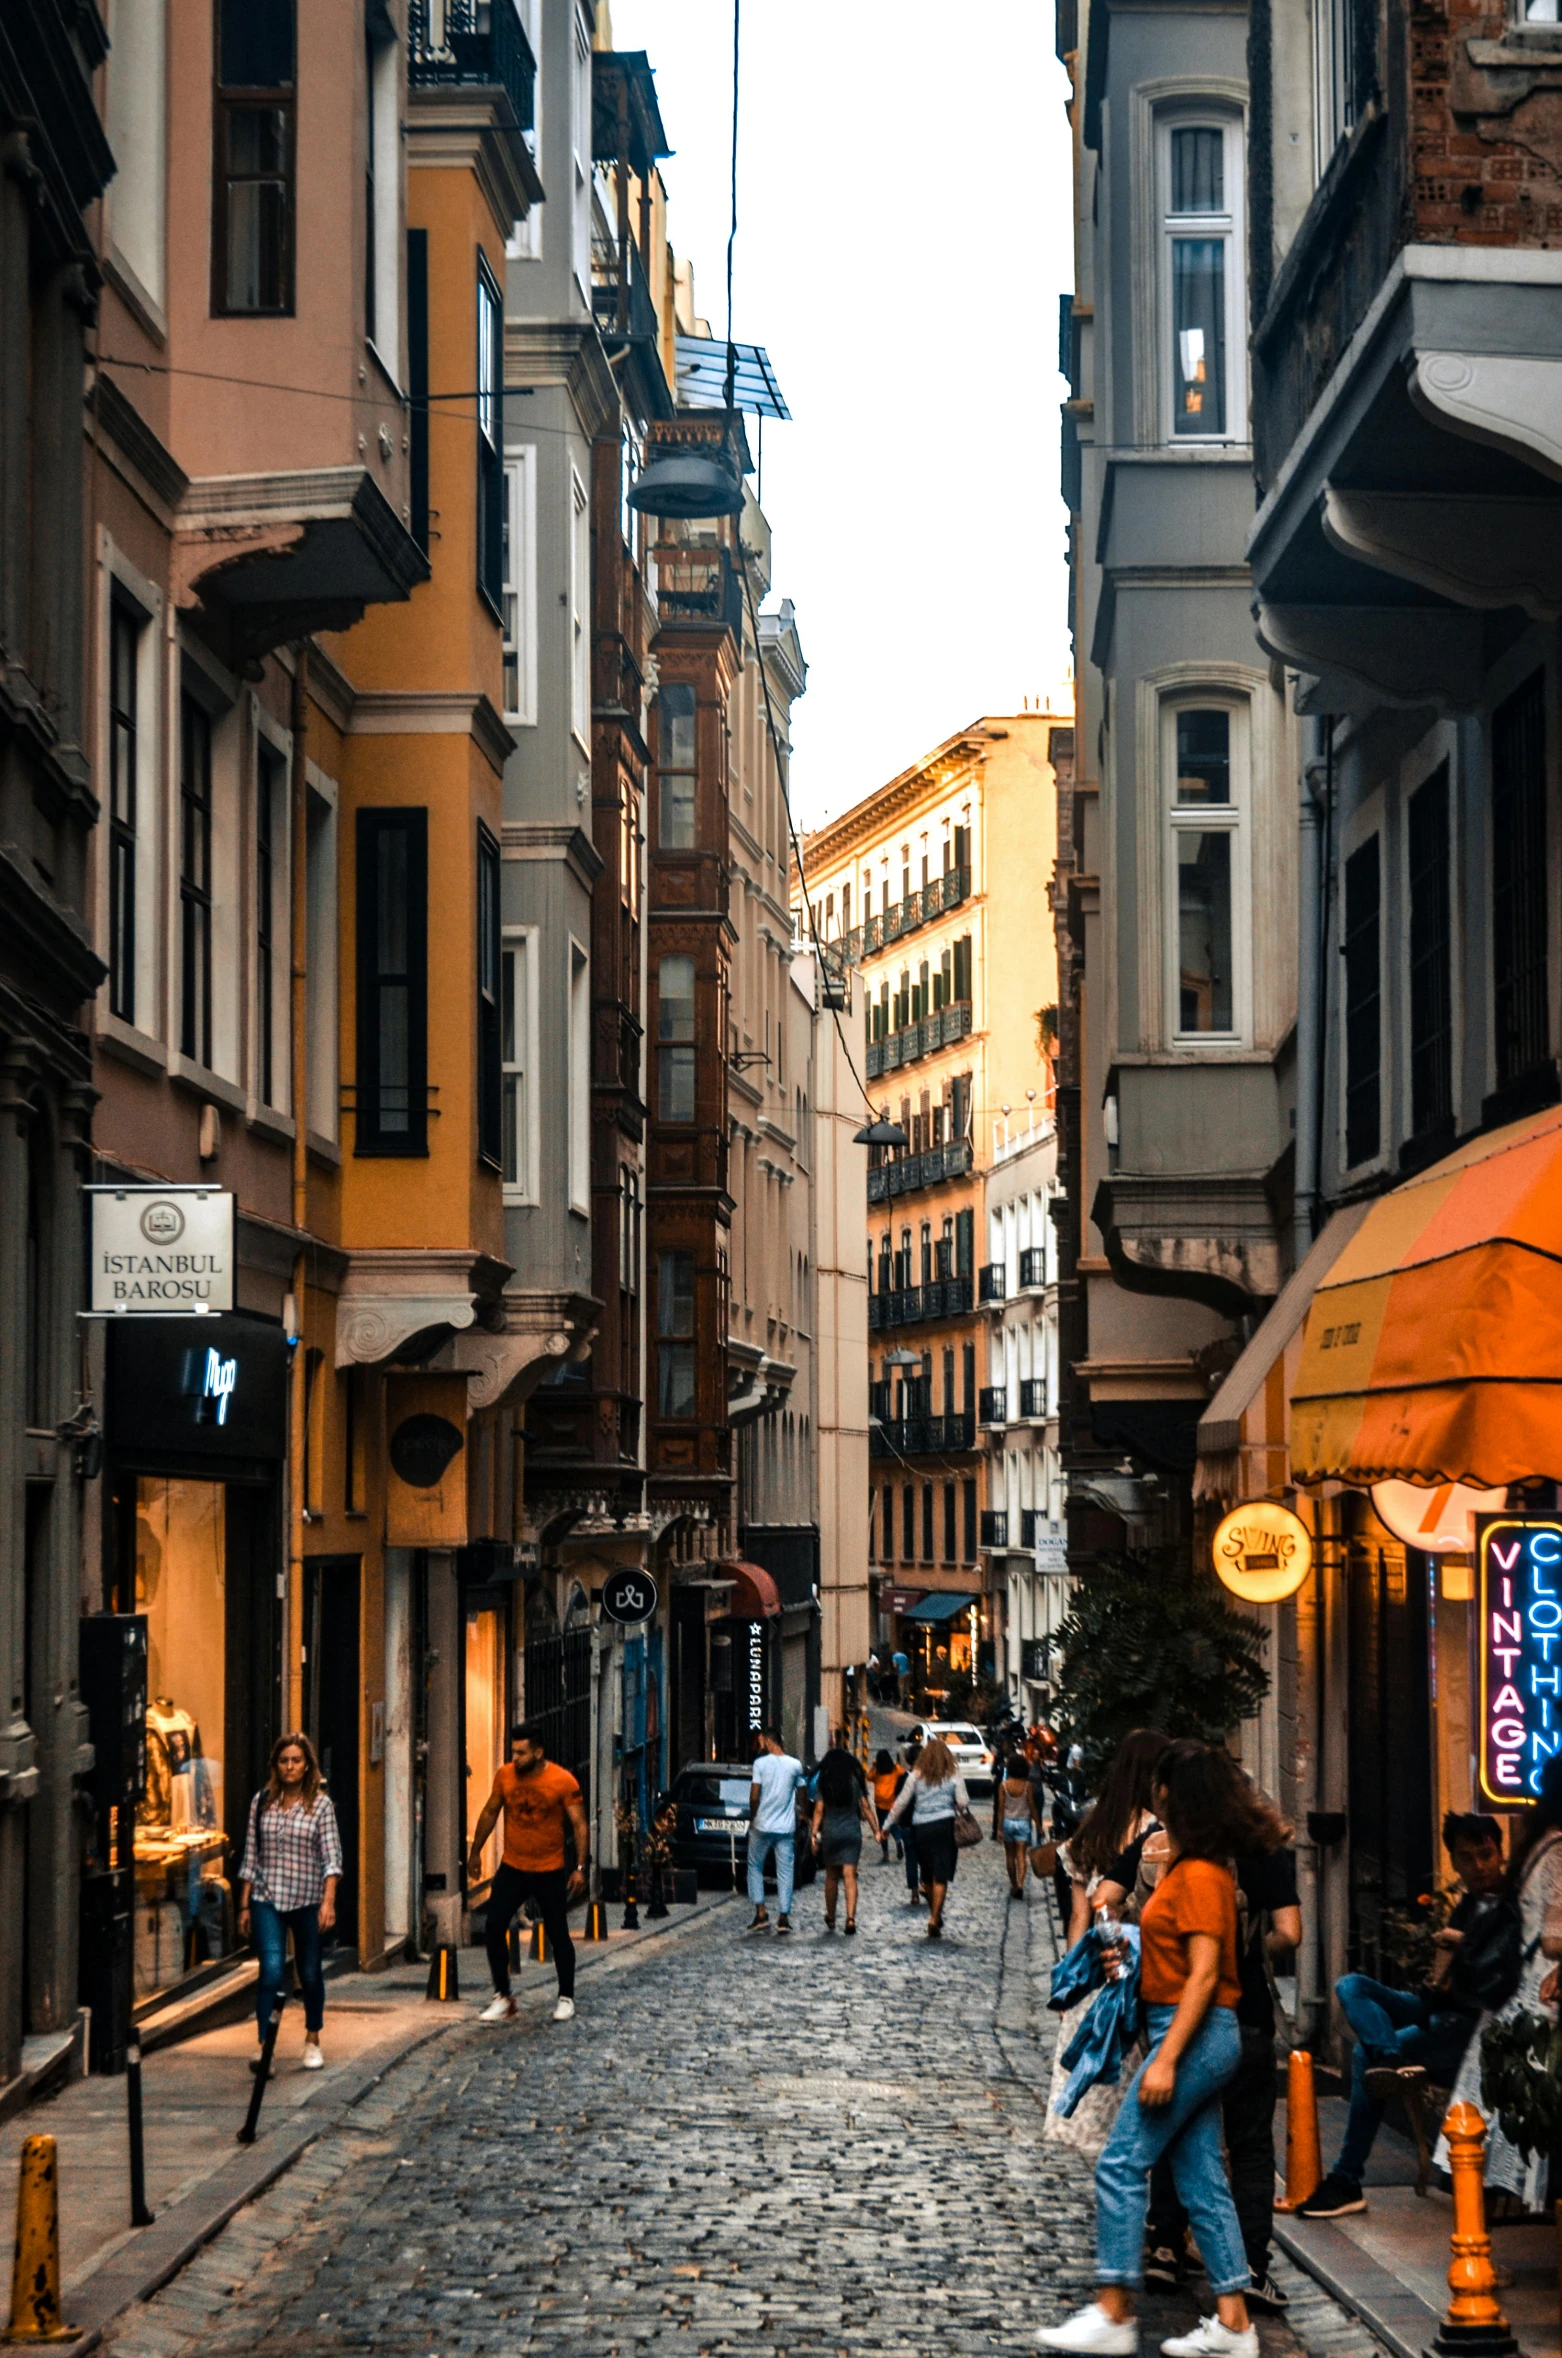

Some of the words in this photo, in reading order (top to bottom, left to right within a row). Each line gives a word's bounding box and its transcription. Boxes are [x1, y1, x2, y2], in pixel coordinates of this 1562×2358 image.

[103, 1251, 222, 1274] İSTANBUL
[113, 1281, 211, 1299] BAROSU
[1222, 1526, 1296, 1558] SWING
[1490, 1541, 1527, 1786] VINTAGE
[749, 1637, 762, 1731] LUNAPARK
